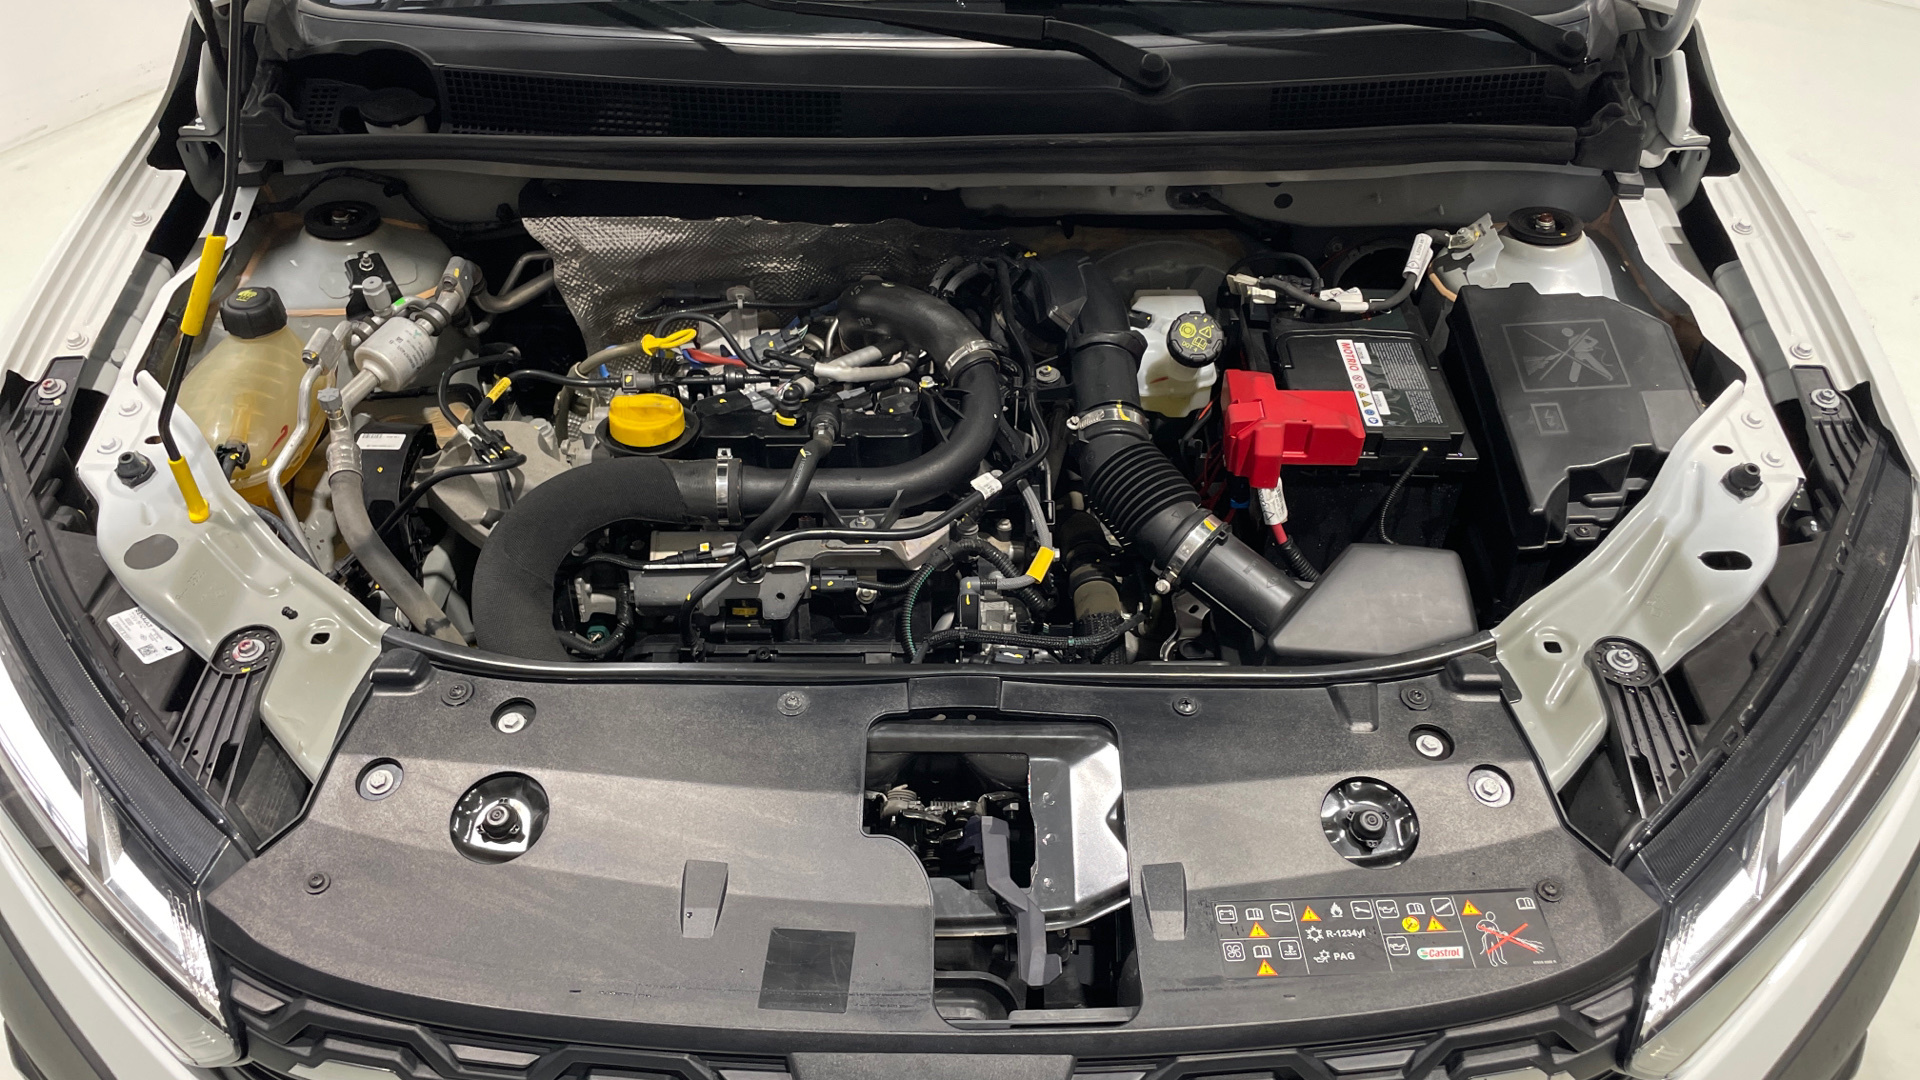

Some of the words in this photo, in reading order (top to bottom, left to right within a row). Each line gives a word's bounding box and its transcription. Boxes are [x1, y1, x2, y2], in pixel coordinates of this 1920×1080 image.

[1181, 340, 1193, 349] DOT
[1341, 342, 1359, 371] MOTRIO
[135, 609, 153, 628] RENAULT
[1326, 928, 1366, 939] R-1234yf
[1333, 952, 1355, 961] PAG
[1429, 948, 1460, 958] Castrol
